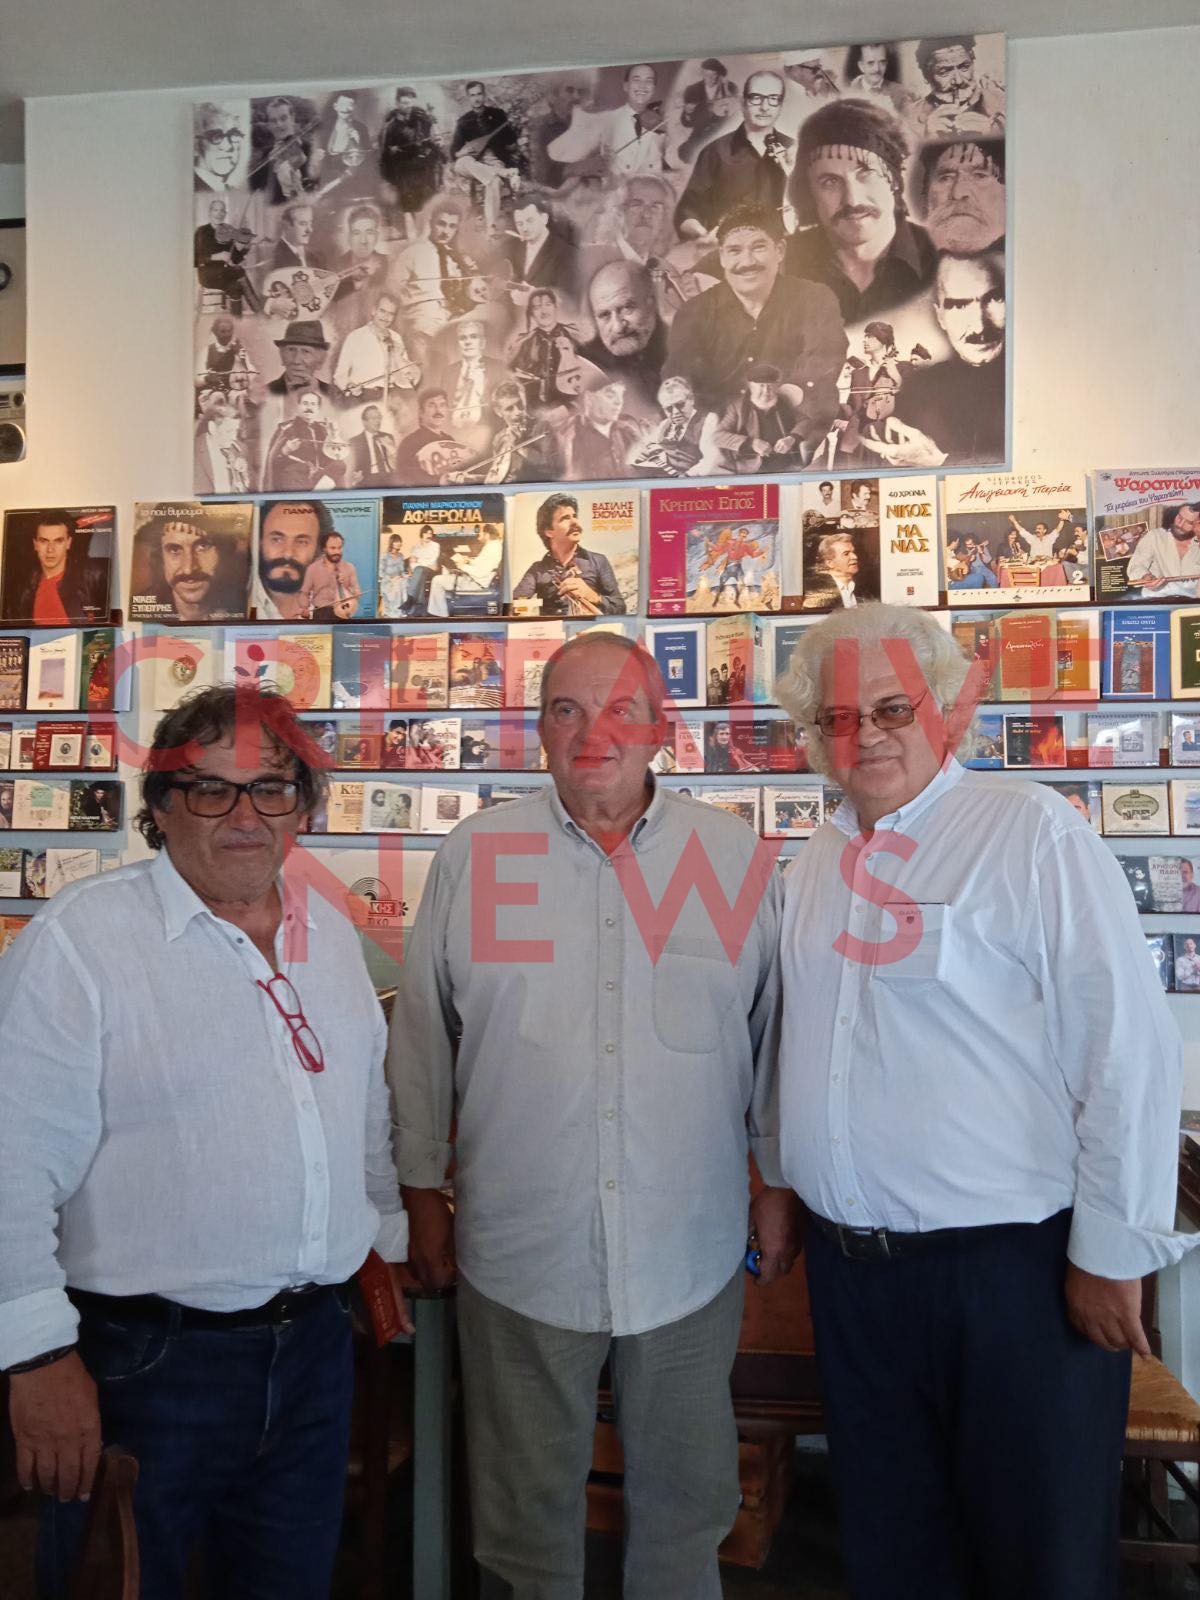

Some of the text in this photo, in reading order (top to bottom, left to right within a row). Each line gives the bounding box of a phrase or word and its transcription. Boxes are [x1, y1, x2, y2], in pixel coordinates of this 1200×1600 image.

[888, 490, 898, 498] 40
[592, 501, 634, 510] ΒΑΣΙΛΗΣ
[659, 496, 755, 513] ΚΡΗΤΩΝ ΕΠΟΣ
[886, 502, 932, 519] ΝΙΚΟΣ
[402, 508, 483, 523] ΑΦΙΕΡΩΜΑ
[592, 510, 634, 519] ΣΚΟΥΛΑΣ
[896, 524, 923, 539] ΜΑ
[890, 538, 930, 554] ΝΙΑΣ
[1071, 570, 1085, 584] 2
